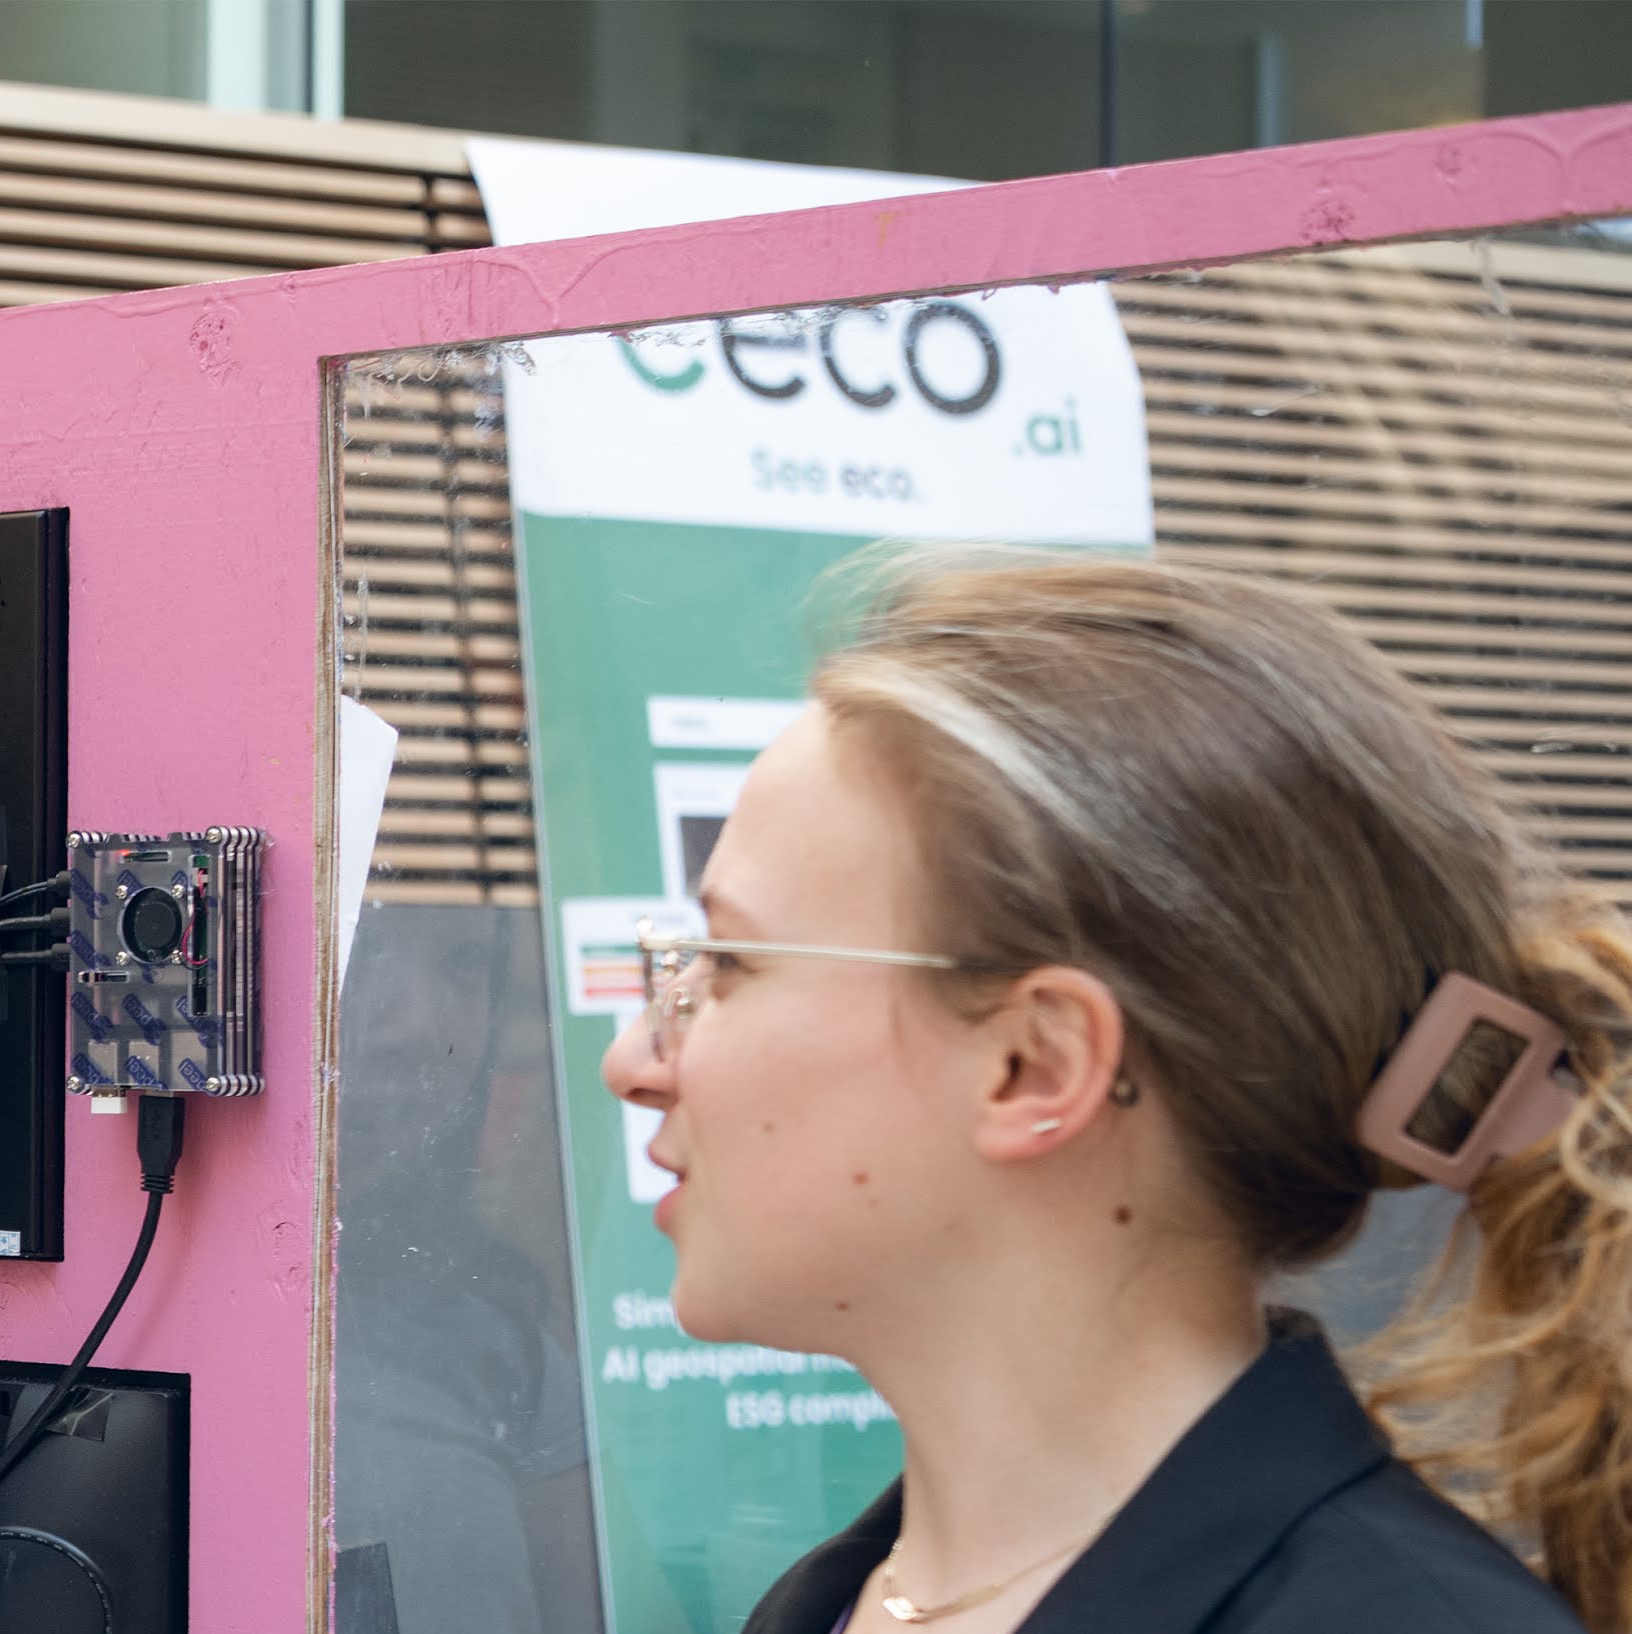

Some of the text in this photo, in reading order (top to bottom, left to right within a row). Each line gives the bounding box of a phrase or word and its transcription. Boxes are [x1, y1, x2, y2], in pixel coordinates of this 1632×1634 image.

[1011, 399, 1082, 457] .ai
[751, 450, 826, 489] See
[726, 1389, 785, 1429] ESG
